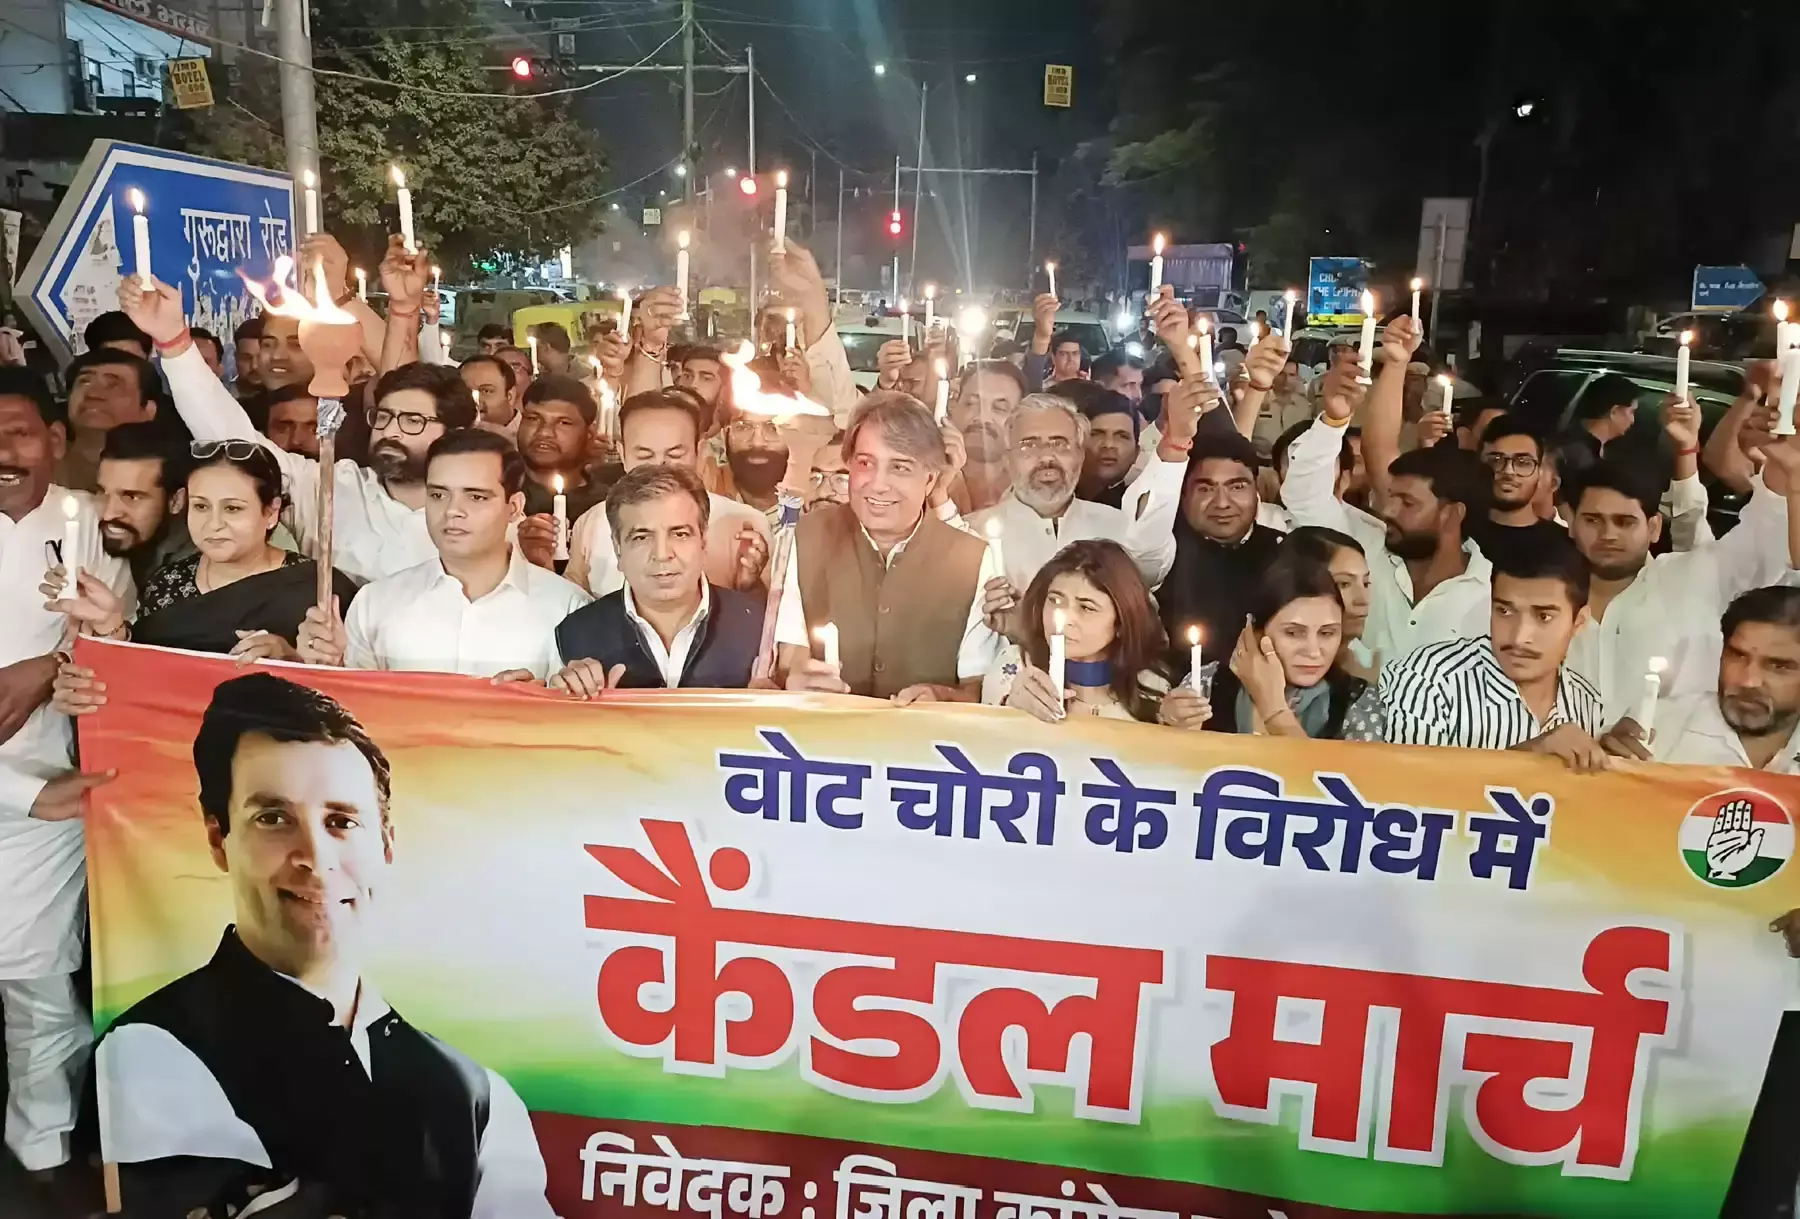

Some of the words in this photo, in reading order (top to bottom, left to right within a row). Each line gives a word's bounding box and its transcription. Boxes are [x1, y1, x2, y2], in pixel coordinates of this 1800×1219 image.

[720, 733, 871, 829] वोट
[888, 746, 1065, 845] चोरी
[1085, 761, 1175, 852] के
[1194, 772, 1448, 879] विरोध
[1472, 788, 1550, 889] में
[584, 819, 1164, 1110] कैंडल
[1206, 928, 1669, 1165] मार्च
[580, 1132, 790, 1219] निवेदक
